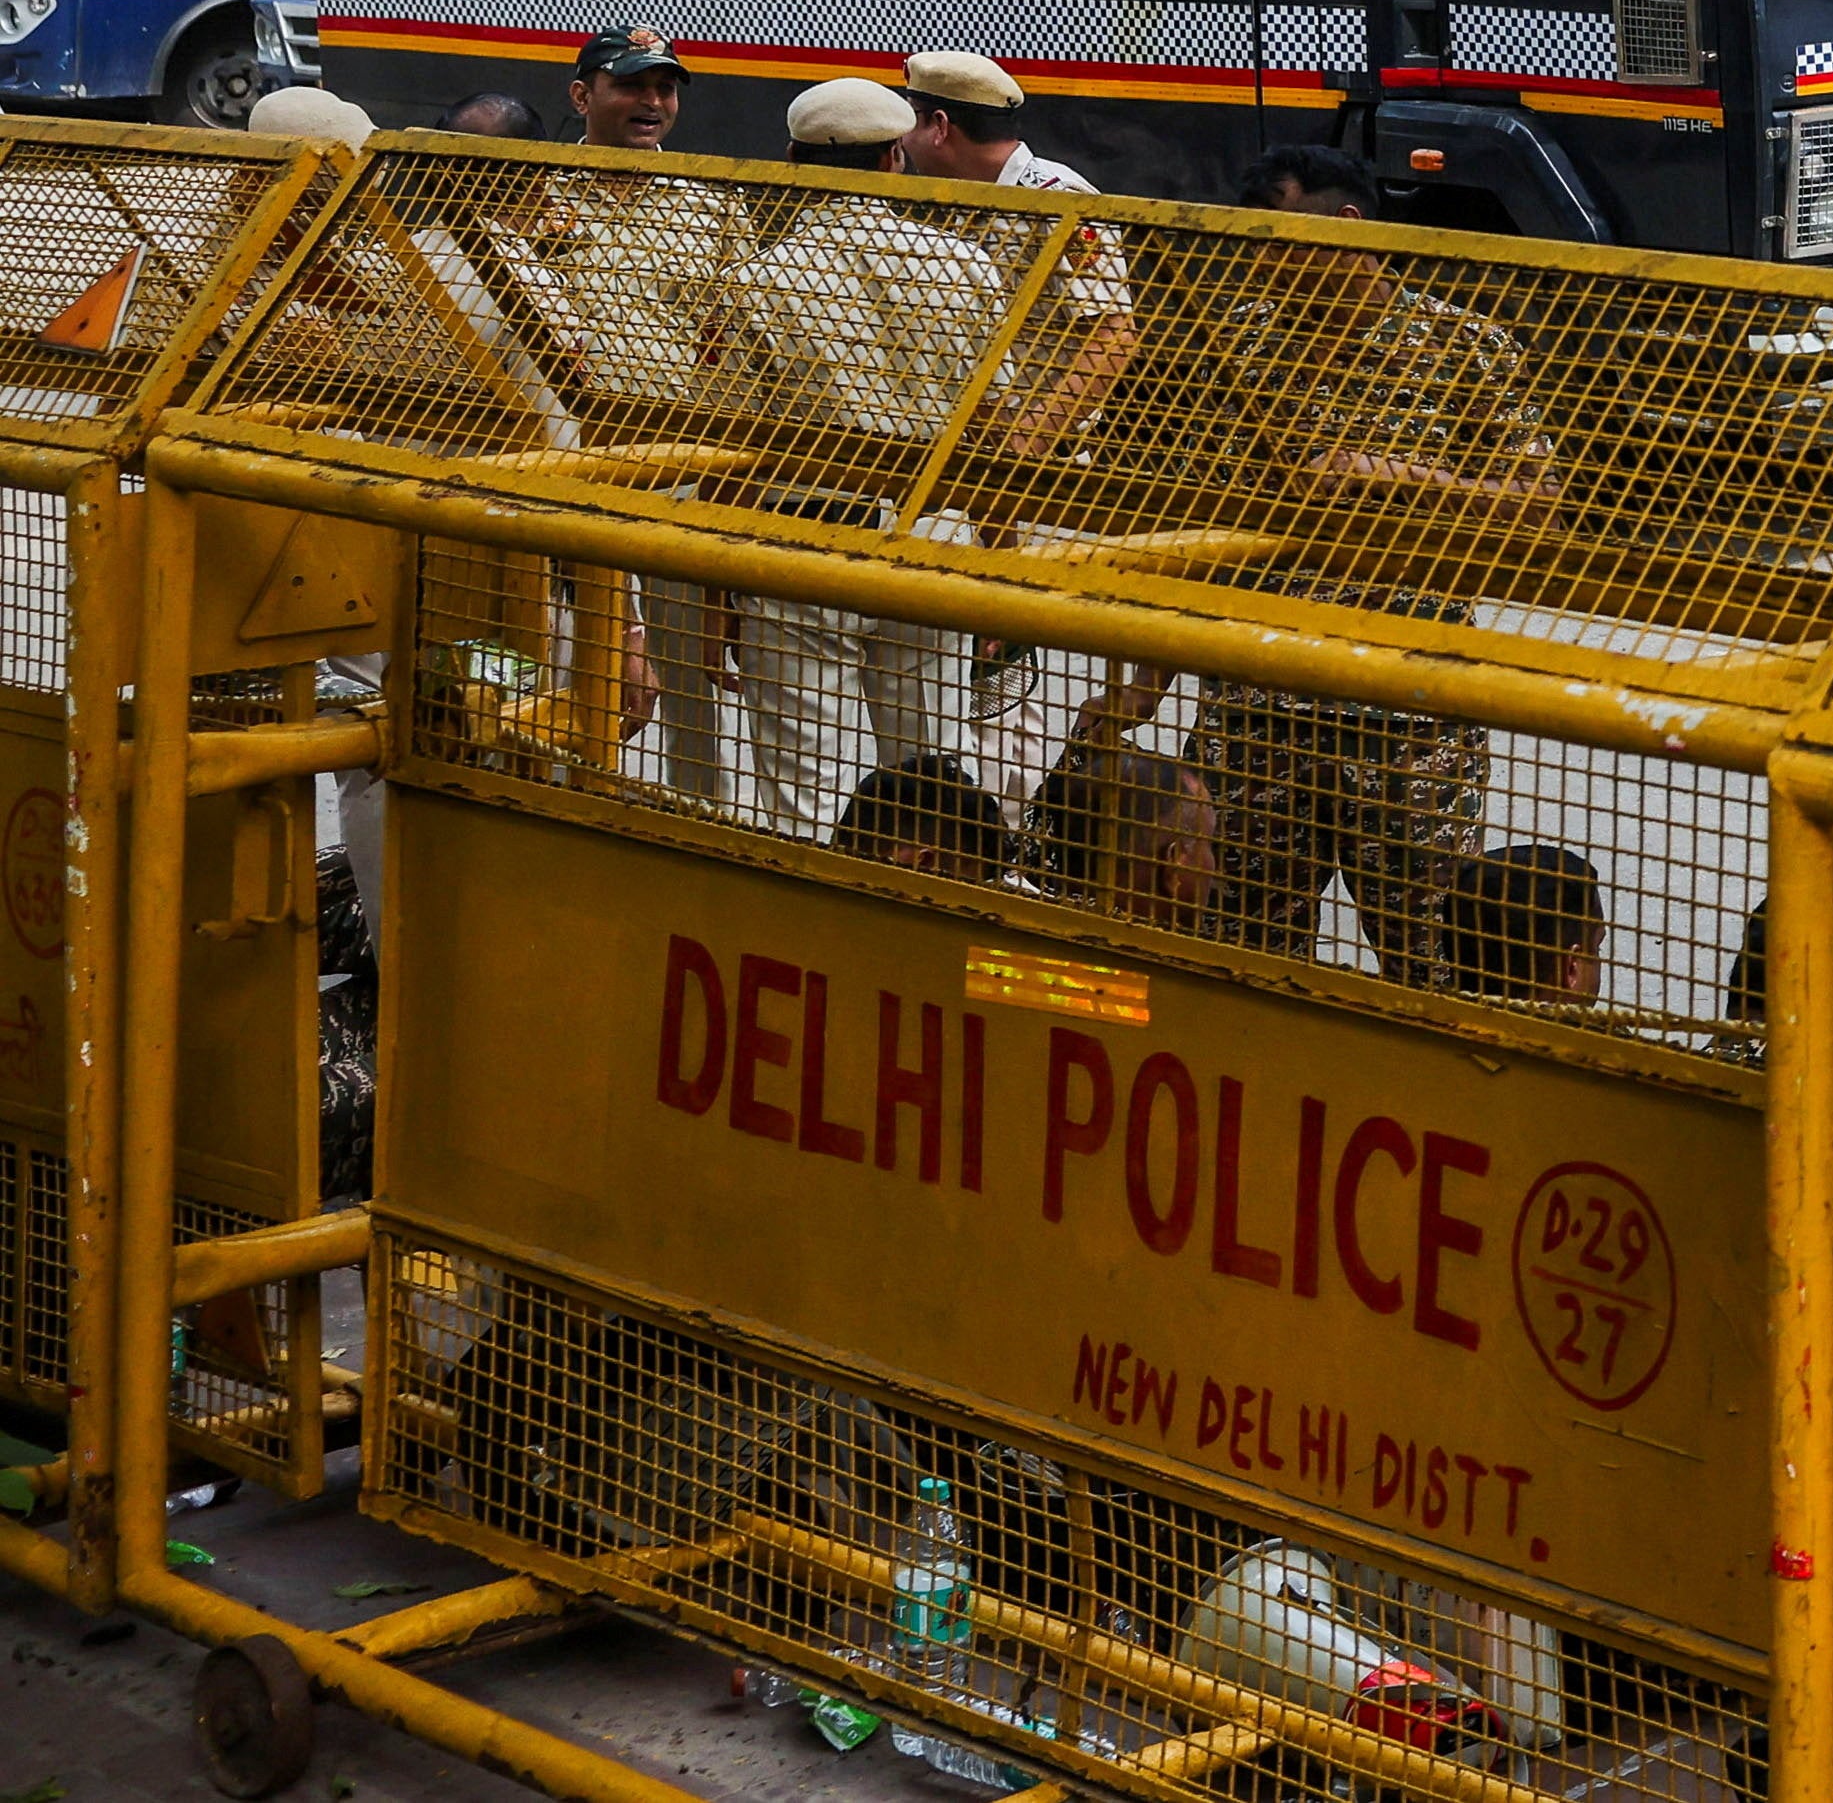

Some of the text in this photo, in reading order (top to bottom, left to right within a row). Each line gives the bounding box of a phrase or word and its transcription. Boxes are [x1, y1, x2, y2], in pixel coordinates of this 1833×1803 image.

[1663, 117, 1712, 133] 1115 HE
[656, 933, 1490, 1352] DELHI POLICE
[1554, 1291, 1628, 1386] 27
[1073, 1333, 1551, 1563] NEW DELHI DISTT.
